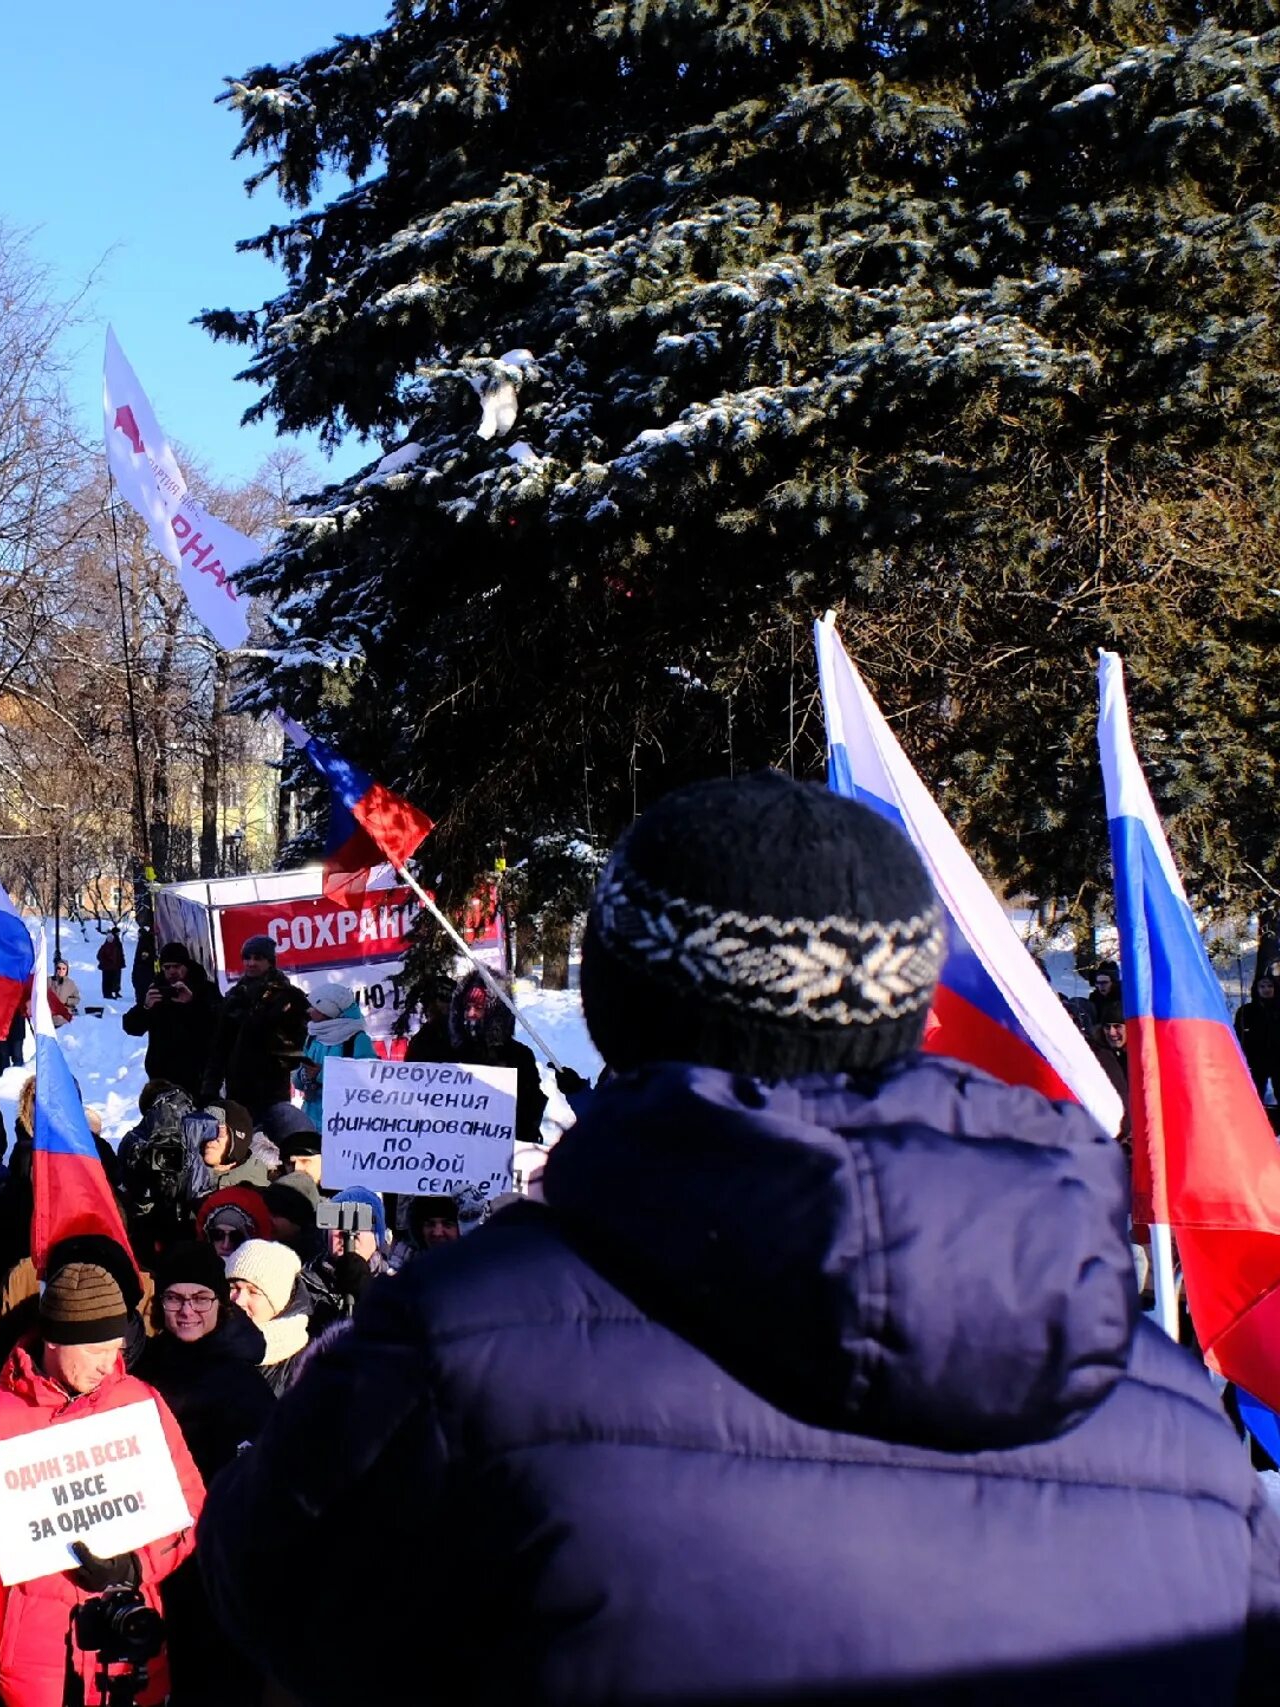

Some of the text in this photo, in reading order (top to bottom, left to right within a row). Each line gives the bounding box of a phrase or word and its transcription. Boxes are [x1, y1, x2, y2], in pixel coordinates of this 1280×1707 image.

[370, 1063, 473, 1087] Требуем
[343, 1087, 489, 1110] увеличения
[327, 1111, 513, 1140] финансирования
[382, 1137, 413, 1153] по
[341, 1150, 466, 1174] "Молодой
[417, 1172, 508, 1197] семе"!
[4, 1435, 142, 1491] ОДИН ЗА ВСЕХ
[51, 1474, 107, 1506] И ВСЕ
[28, 1491, 147, 1542] ЗА ОДНОГО!
